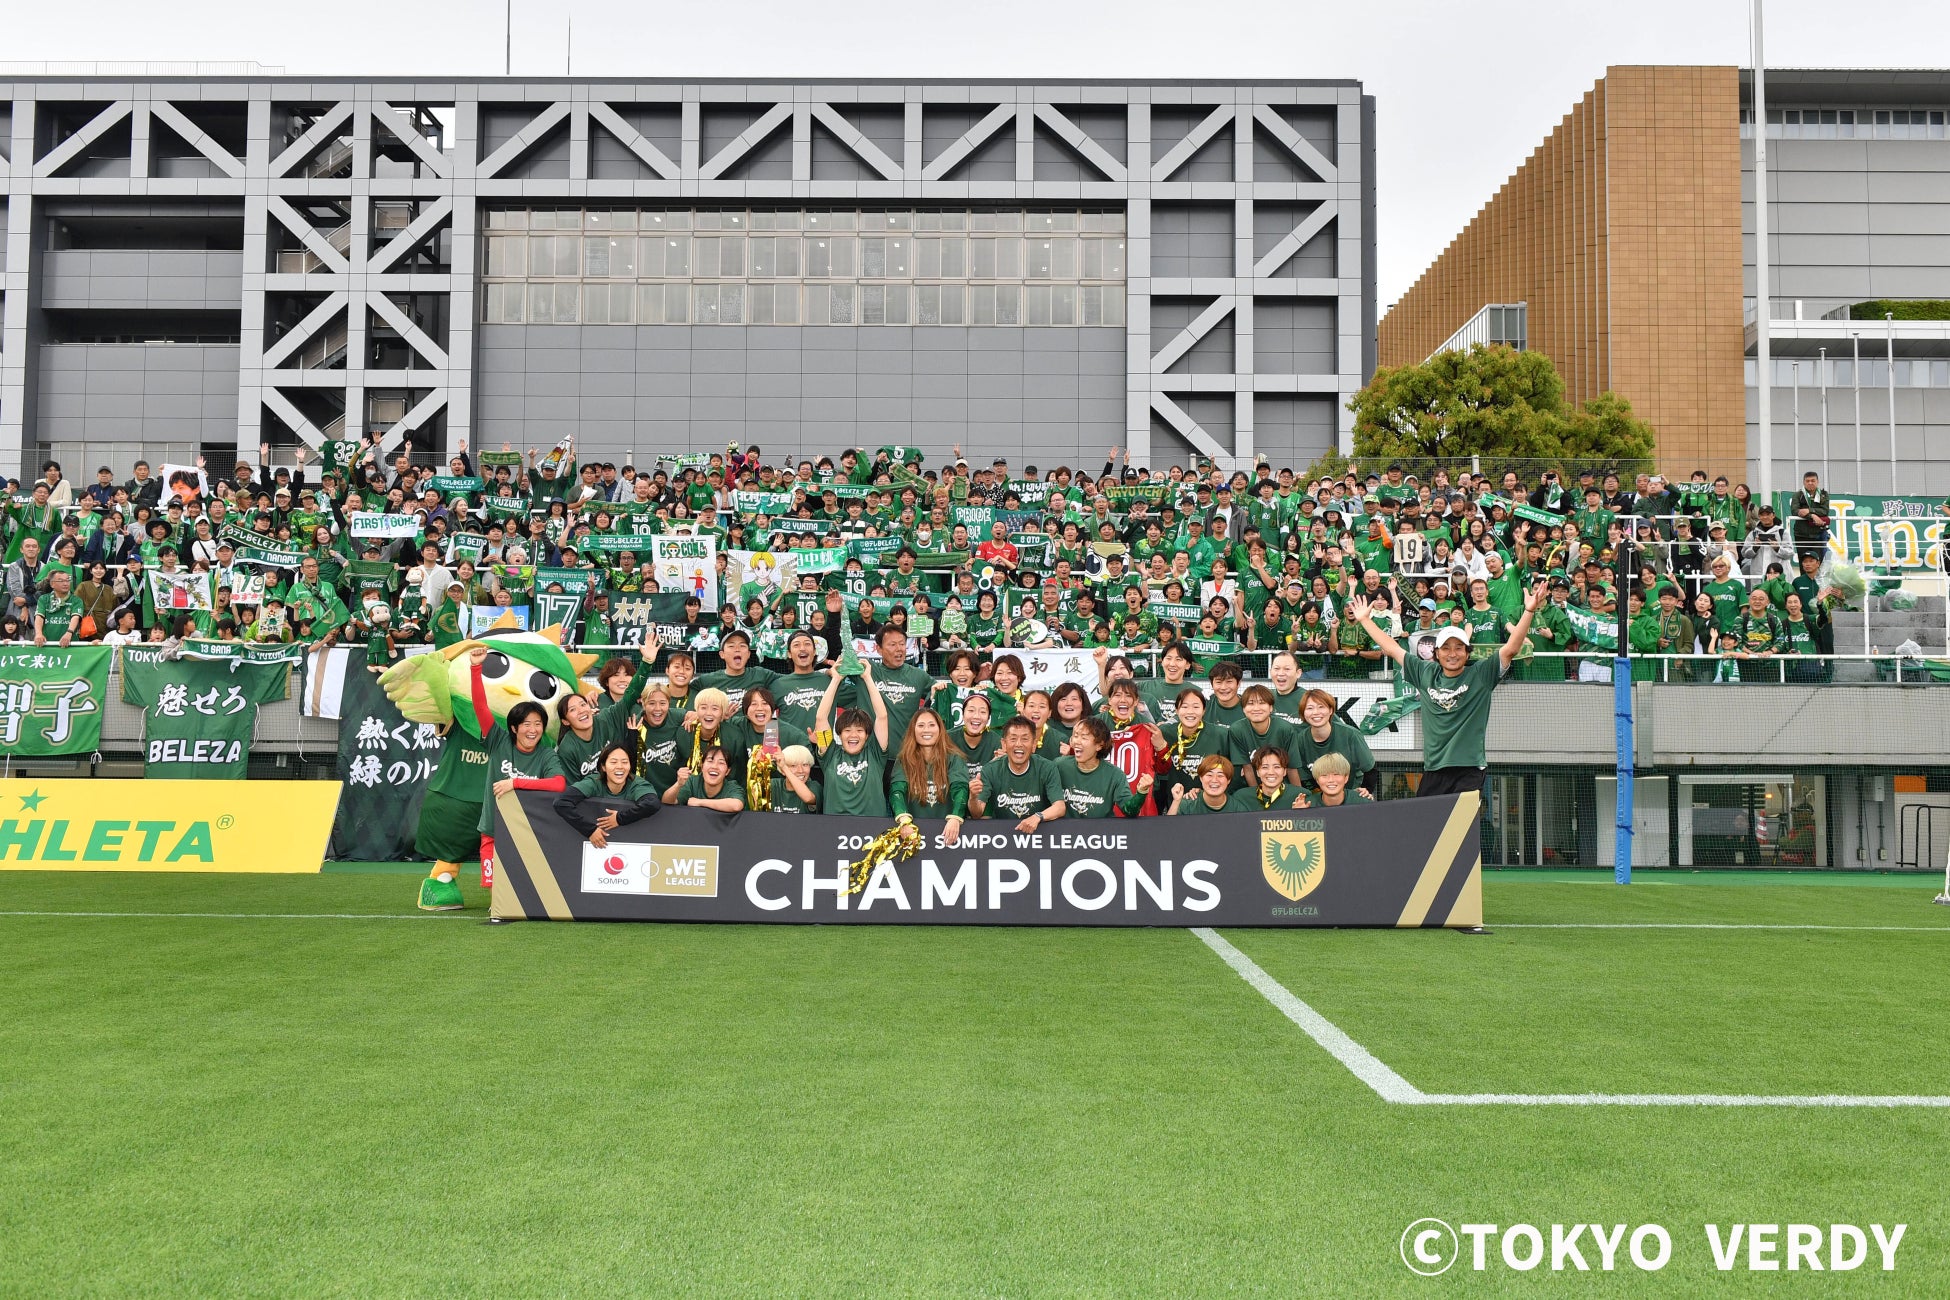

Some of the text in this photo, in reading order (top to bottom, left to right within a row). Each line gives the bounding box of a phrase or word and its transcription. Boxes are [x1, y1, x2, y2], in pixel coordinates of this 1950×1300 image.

[493, 497, 523, 509] YUZUKI
[354, 517, 384, 529] FIRST
[956, 507, 991, 524] PRIDE
[1399, 539, 1417, 560] 19
[537, 593, 580, 646] 17
[611, 596, 652, 626] 木村
[797, 601, 818, 625] 19
[1152, 605, 1201, 618] 32 HARUHI
[656, 626, 689, 638] FIRST
[201, 644, 209, 653] 13
[1192, 642, 1220, 652] MOMO
[153, 682, 248, 723] 魅せろ
[148, 739, 242, 765] BELEZA
[934, 834, 1008, 850] SOMPO
[1013, 834, 1042, 850] WE
[1050, 834, 1128, 851] LEAGUE
[598, 877, 629, 886] SOMPO
[666, 877, 706, 888] LEAGUE
[744, 857, 1222, 913] CHAMPIONS
